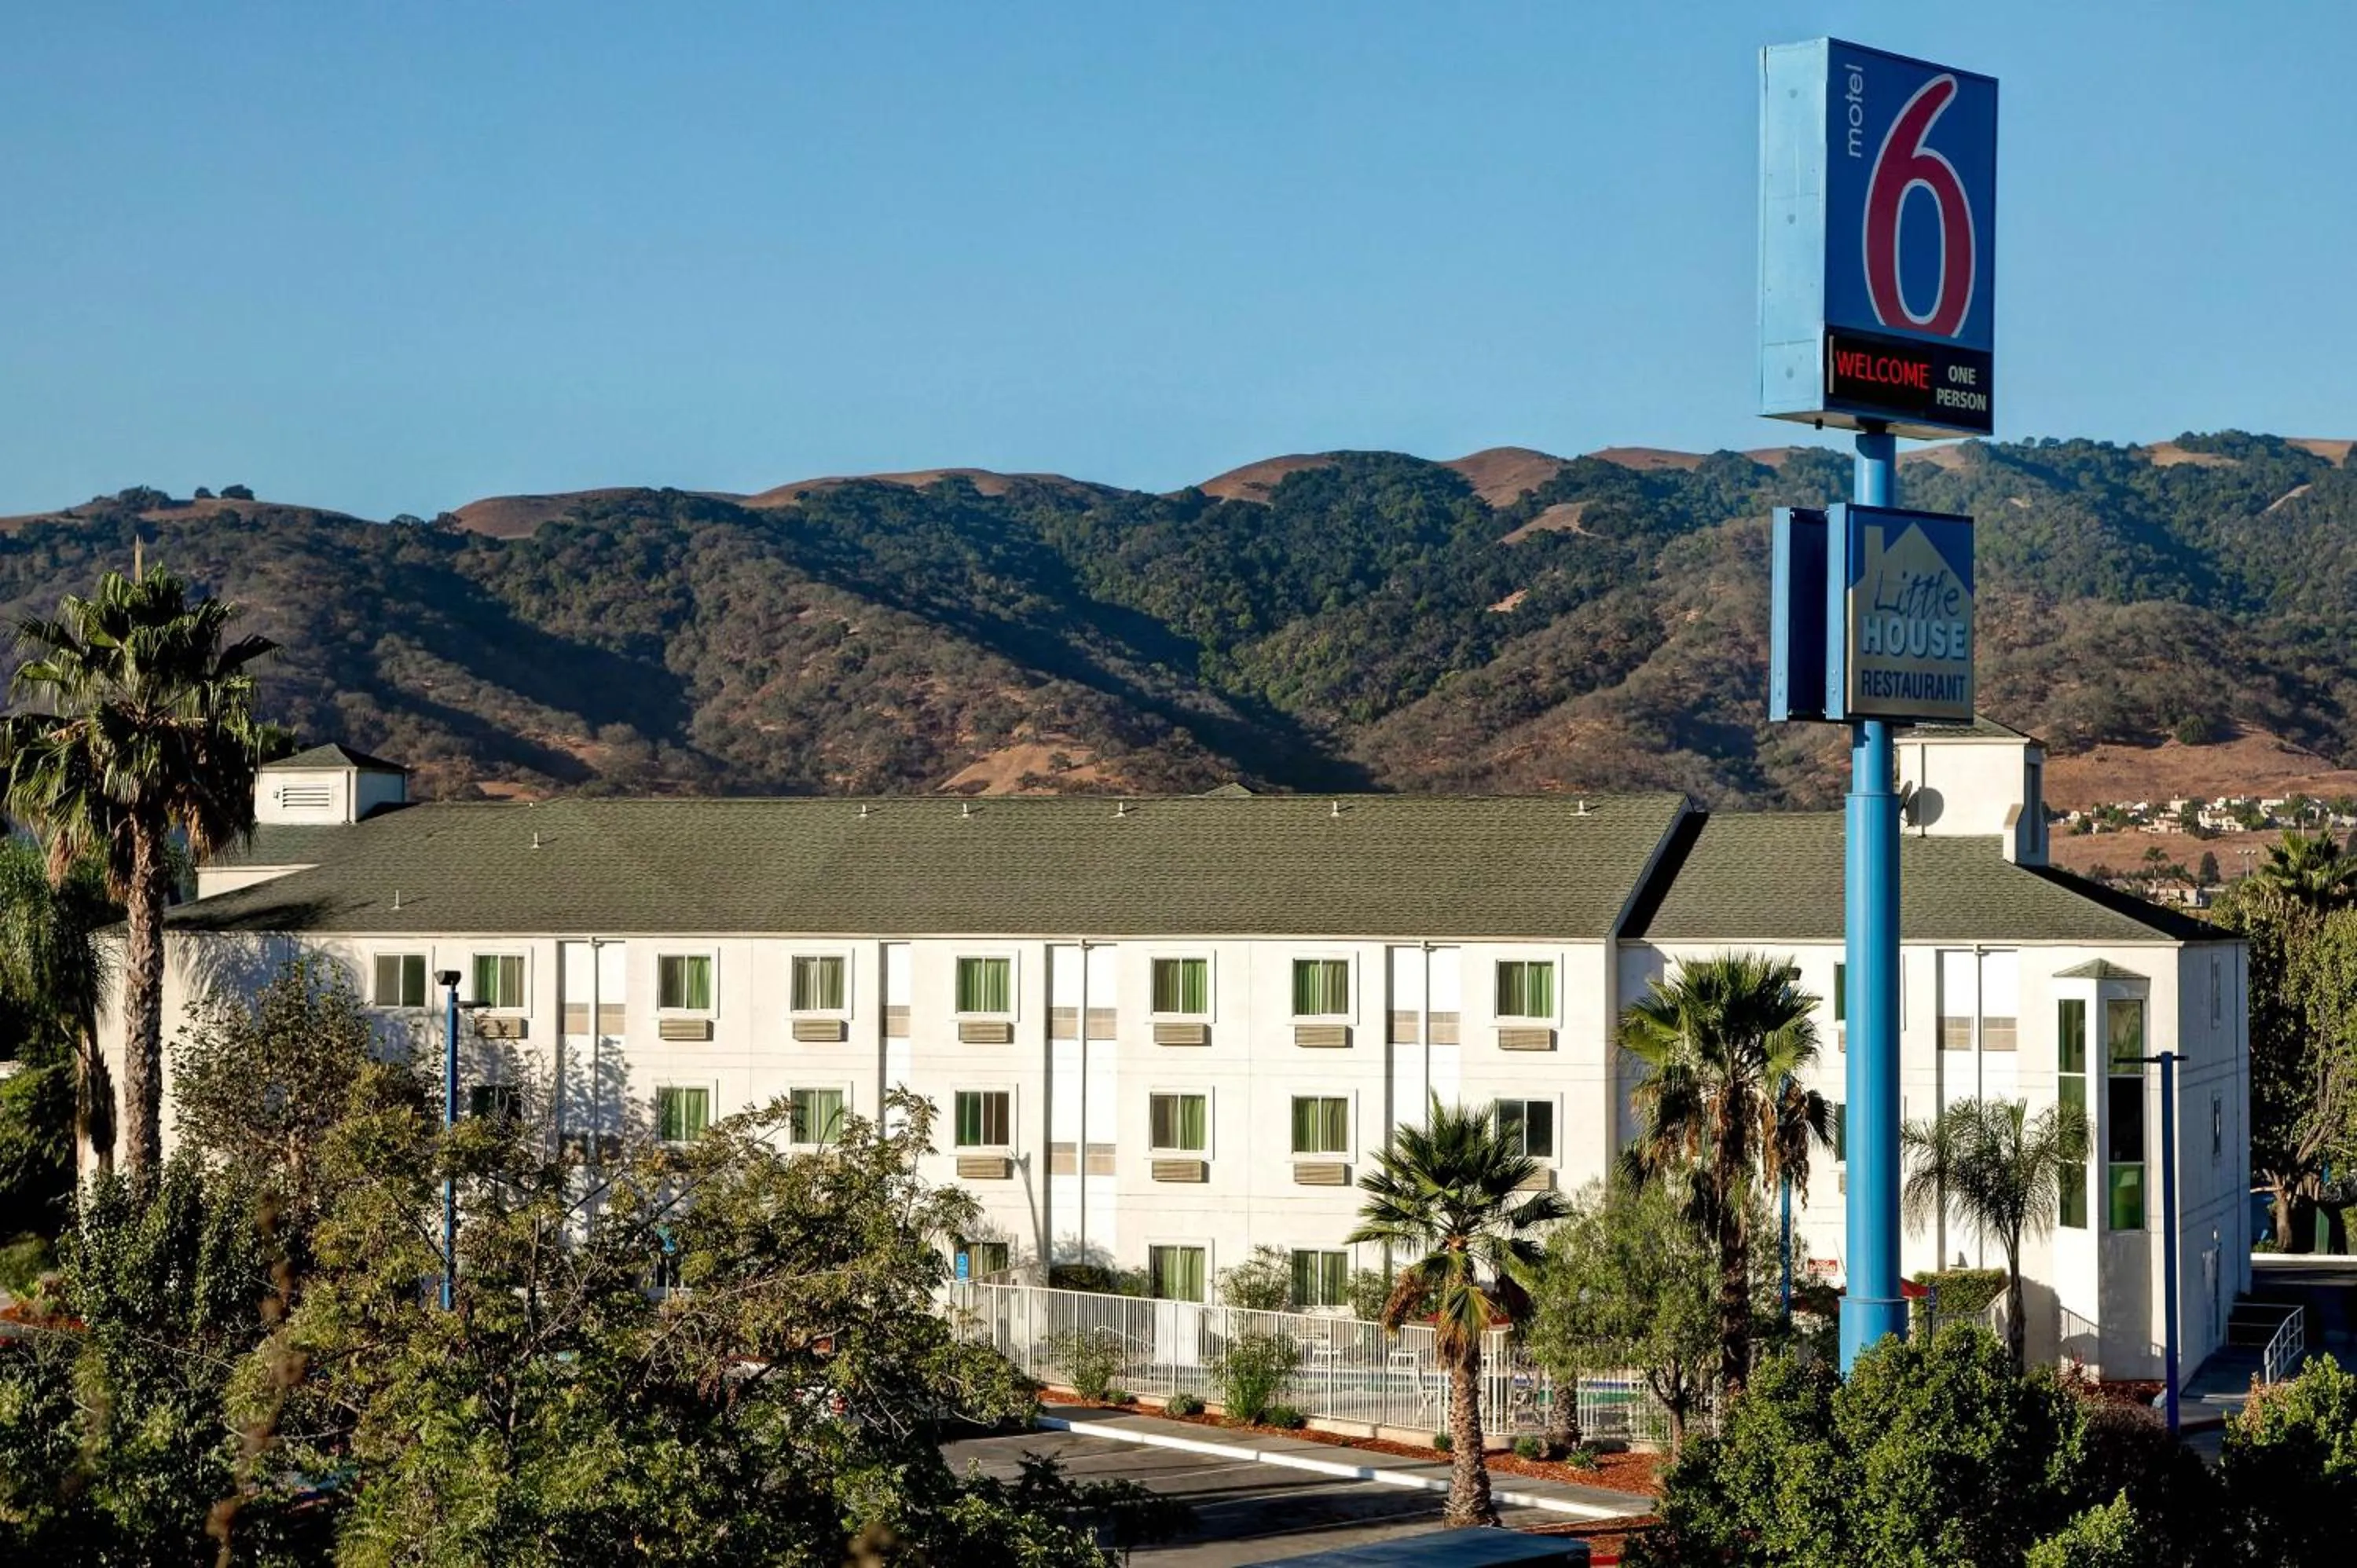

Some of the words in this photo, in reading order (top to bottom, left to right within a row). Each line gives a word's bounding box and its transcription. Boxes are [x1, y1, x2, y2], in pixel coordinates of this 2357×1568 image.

[1845, 64, 1863, 158] motel
[1862, 73, 1975, 338] 6
[1836, 350, 1931, 390] WELCOME
[1948, 365, 1976, 385] ONE
[1936, 387, 1987, 412] PERSON
[1875, 569, 1959, 618] Little
[1862, 615, 1967, 660] HOUSE
[1861, 670, 1966, 702] RESTAURANT
